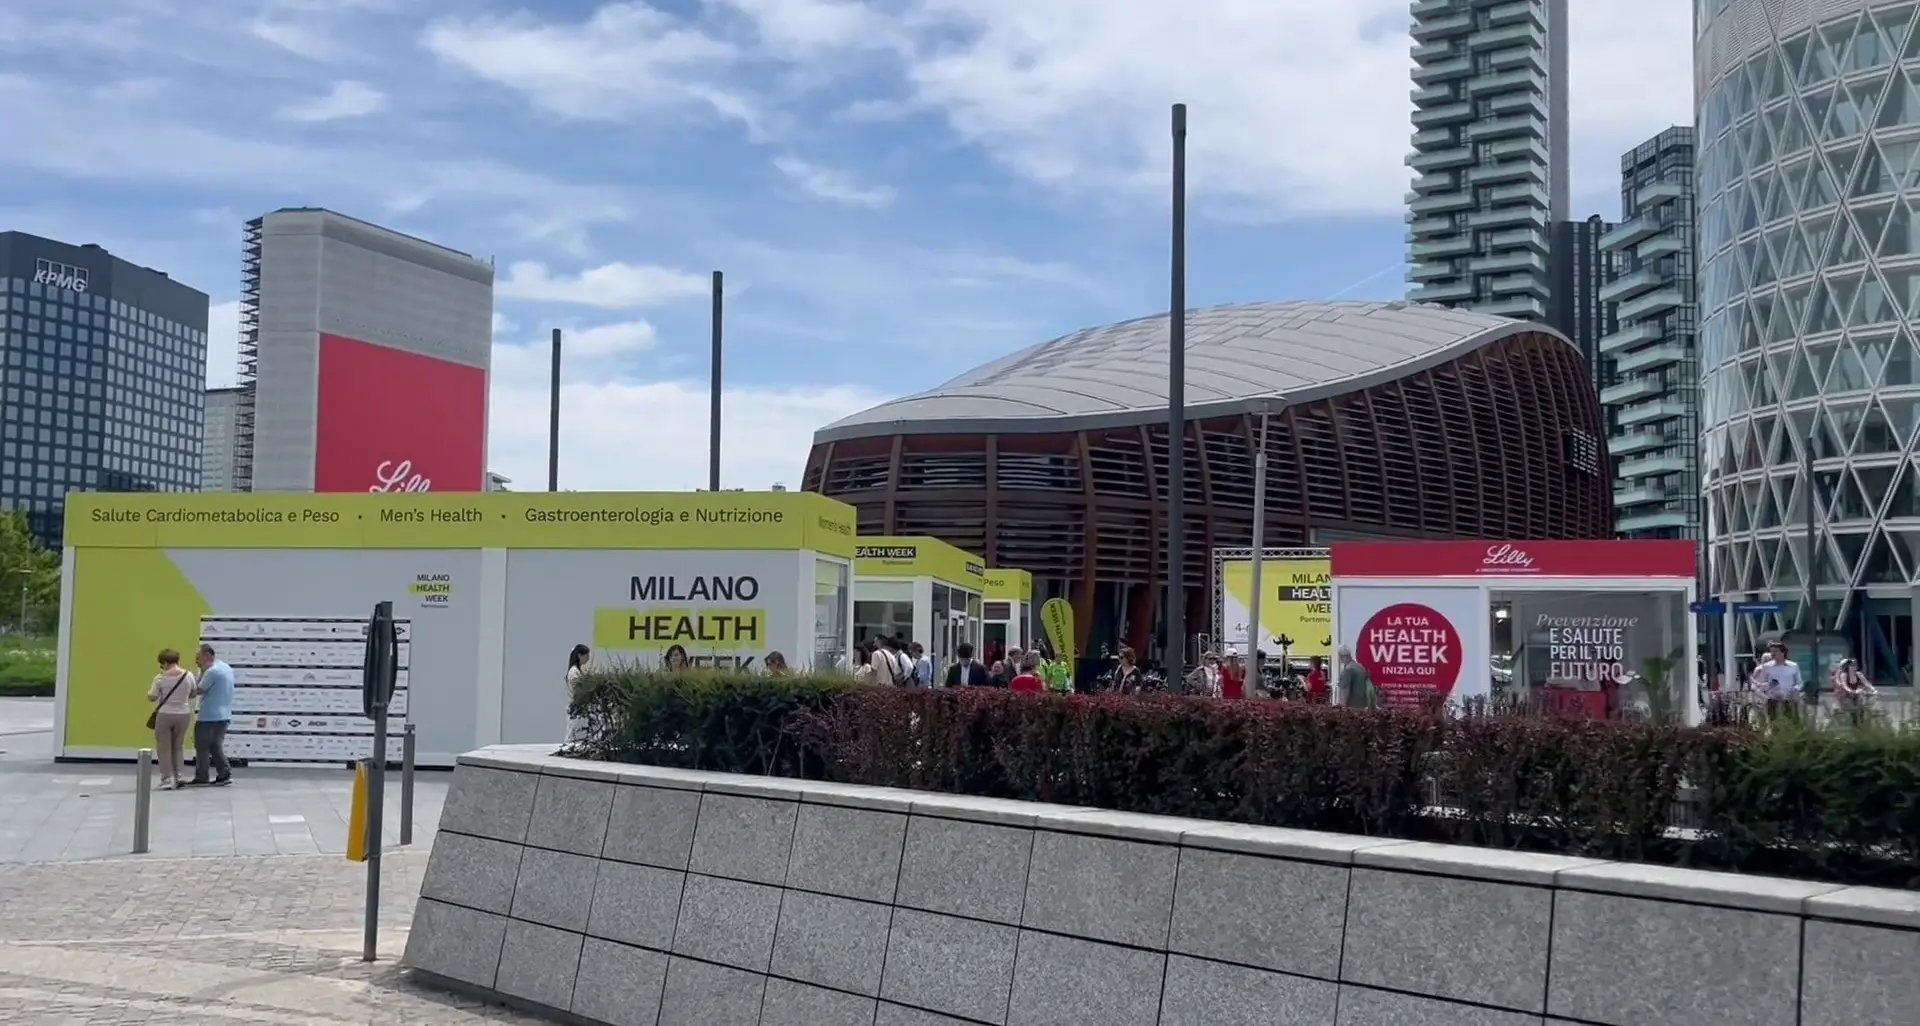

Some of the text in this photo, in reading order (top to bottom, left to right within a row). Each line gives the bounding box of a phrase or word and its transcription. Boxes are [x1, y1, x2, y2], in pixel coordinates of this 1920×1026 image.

[34, 268, 86, 292] KPMG
[369, 460, 431, 492] Lill
[91, 508, 340, 522] Salute Cardiometabolica e Peso
[380, 508, 483, 522] Men's Health
[525, 507, 783, 526] Gastroenterologia e Nutrizione
[856, 548, 914, 557] EALTH WEEK
[1482, 544, 1535, 567] Lilly
[984, 579, 1005, 587] Peso
[1292, 573, 1331, 583] MILAN
[416, 584, 450, 592] HEALTH
[630, 576, 759, 601] MILANO
[1292, 589, 1331, 599] HEALT
[1306, 604, 1331, 613] WEE
[1387, 617, 1429, 626] LA TUA
[1536, 613, 1638, 627] Prevenzione
[629, 616, 757, 640] HEALTH
[1370, 629, 1446, 643] HEALTH
[1549, 628, 1623, 644] E SALUTE
[1369, 645, 1448, 663] WEEK
[1550, 645, 1624, 660] PER IL TUO
[1382, 666, 1436, 675] INIZIA QUI
[1551, 662, 1624, 681] FUTURO
